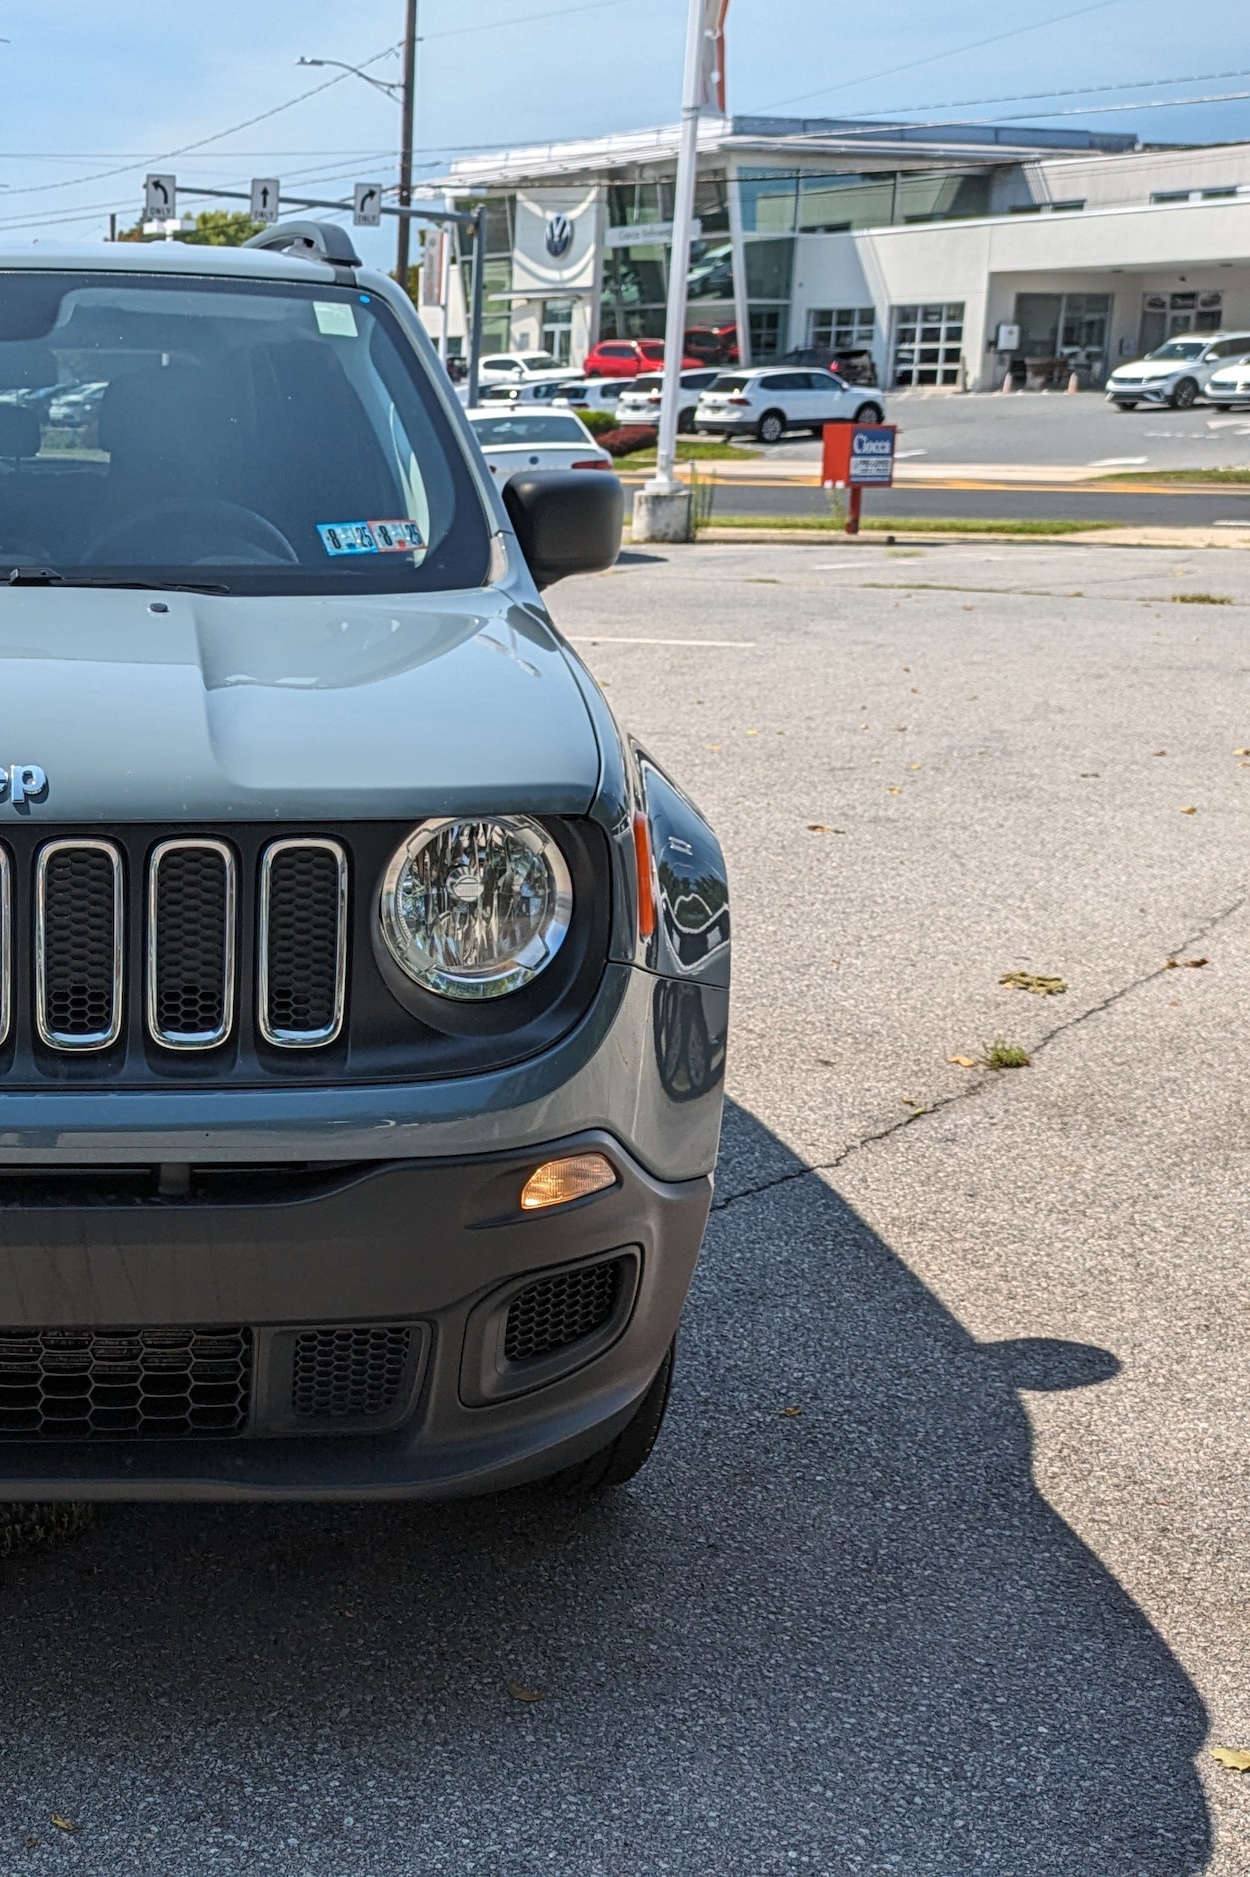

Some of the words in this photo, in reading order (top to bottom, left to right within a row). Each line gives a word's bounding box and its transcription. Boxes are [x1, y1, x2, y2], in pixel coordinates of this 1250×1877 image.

[150, 207, 172, 216] ONLY
[254, 211, 275, 220] ONLY
[327, 528, 342, 550] 8
[378, 525, 393, 546] 8
